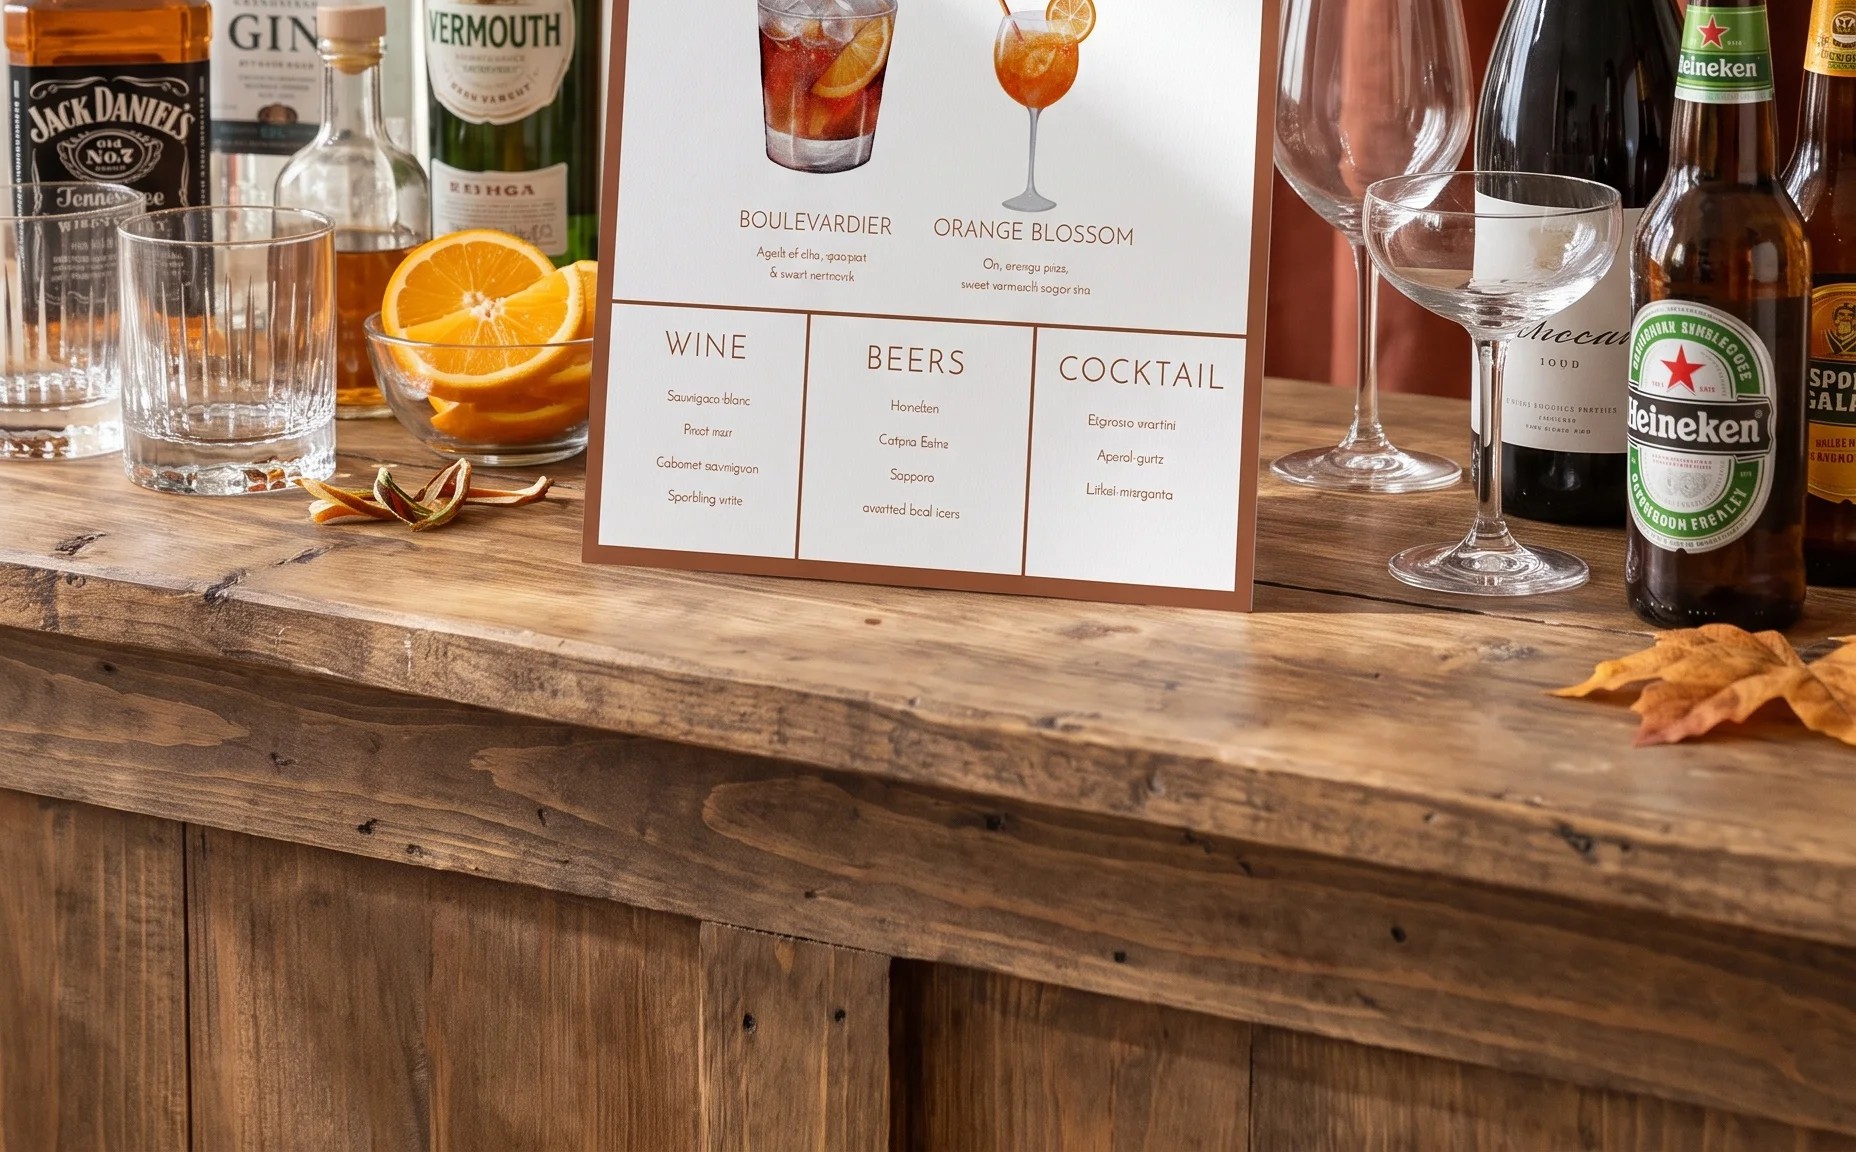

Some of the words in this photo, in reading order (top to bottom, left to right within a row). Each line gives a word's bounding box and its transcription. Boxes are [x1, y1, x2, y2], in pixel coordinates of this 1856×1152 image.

[228, 13, 318, 52] GIN
[429, 10, 562, 48] VERMOUTH
[28, 96, 92, 144] JACK
[86, 148, 134, 165] No.7
[56, 186, 165, 208] Tennesee
[740, 209, 892, 236] BOULEVARDIER
[934, 218, 1023, 241] ORANGE
[1031, 222, 1134, 246] BLOSSOM
[961, 280, 989, 291] sweet
[665, 330, 747, 359] WINE
[868, 345, 964, 375] BEERS
[1059, 355, 1224, 389] COCKTAIL
[1628, 395, 1760, 444] Heineken
[890, 468, 935, 483] Sapporo
